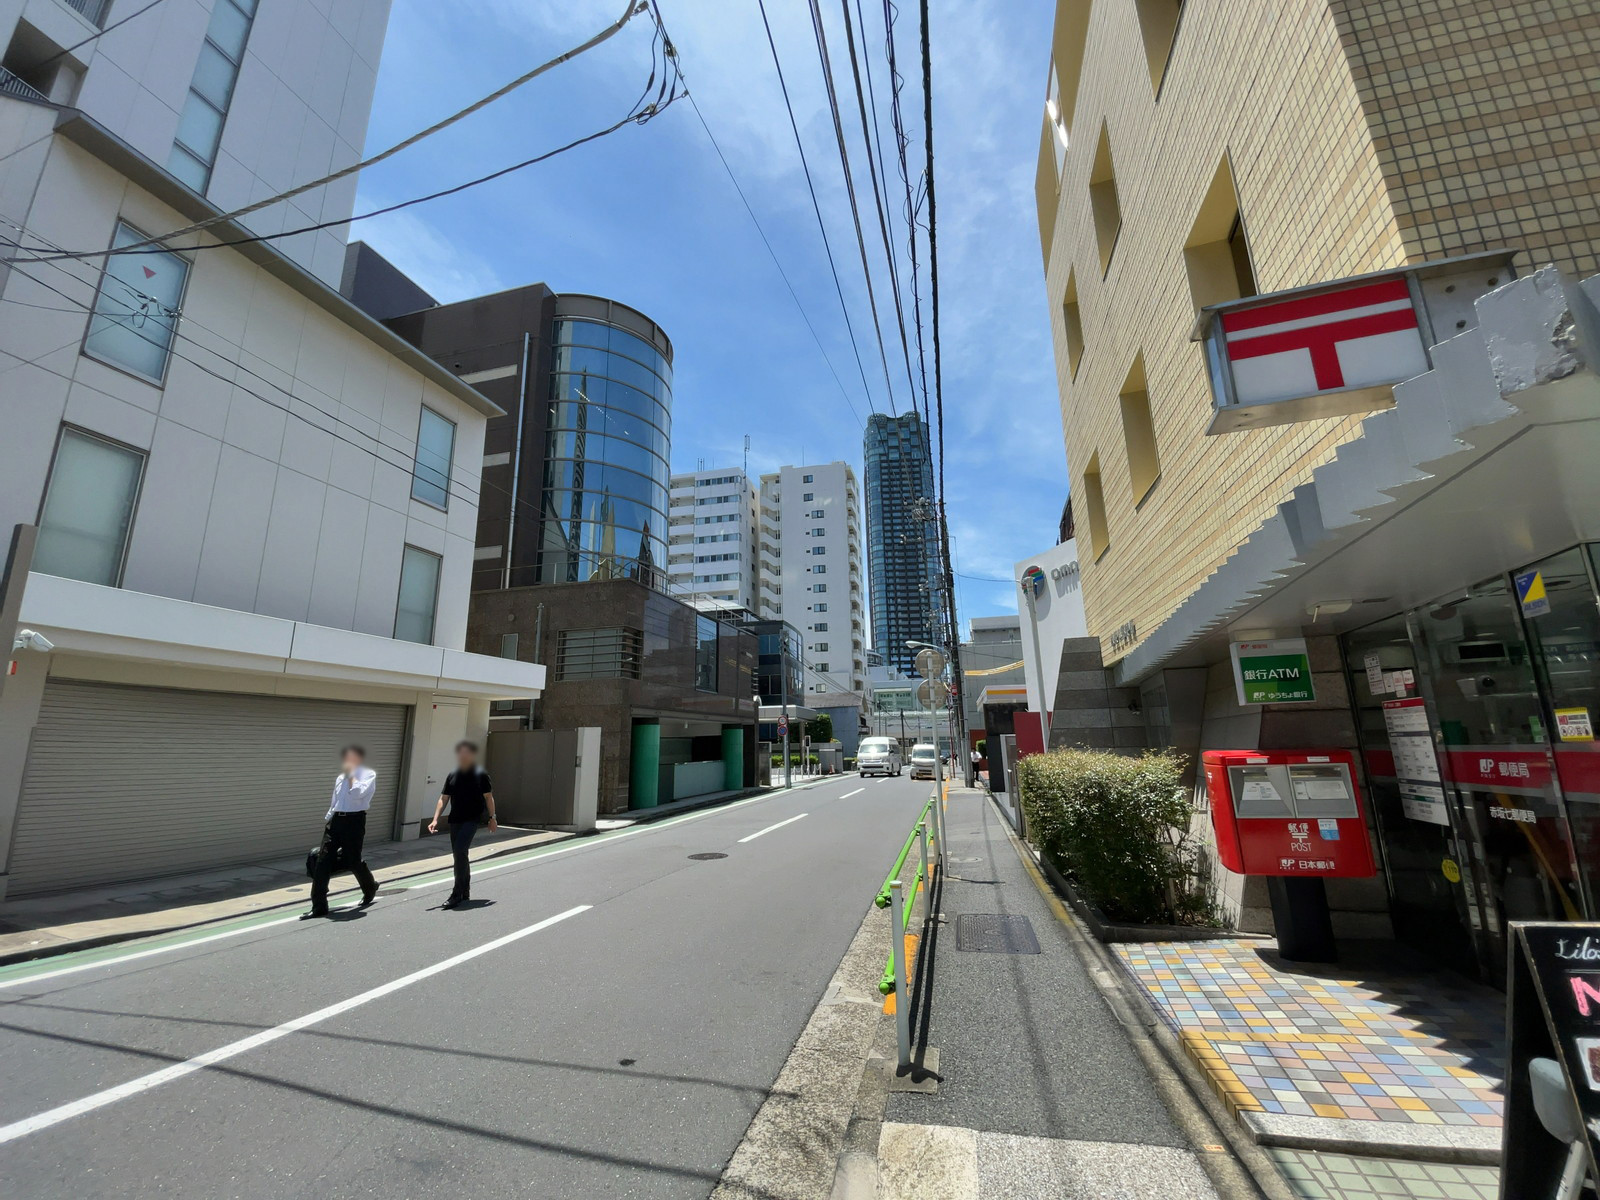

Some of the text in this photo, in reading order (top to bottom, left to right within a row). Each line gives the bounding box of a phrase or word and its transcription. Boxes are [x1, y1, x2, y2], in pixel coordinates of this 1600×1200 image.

[1244, 667, 1299, 680] 銀行ATM
[1268, 690, 1308, 699] ゆうちょ銀行
[1498, 761, 1530, 778] 郵便局
[1489, 806, 1537, 824] 赤坂七郵便局
[1287, 822, 1309, 833] 郵便
[1290, 842, 1312, 852] POST
[1298, 860, 1335, 870] 日本郵便
